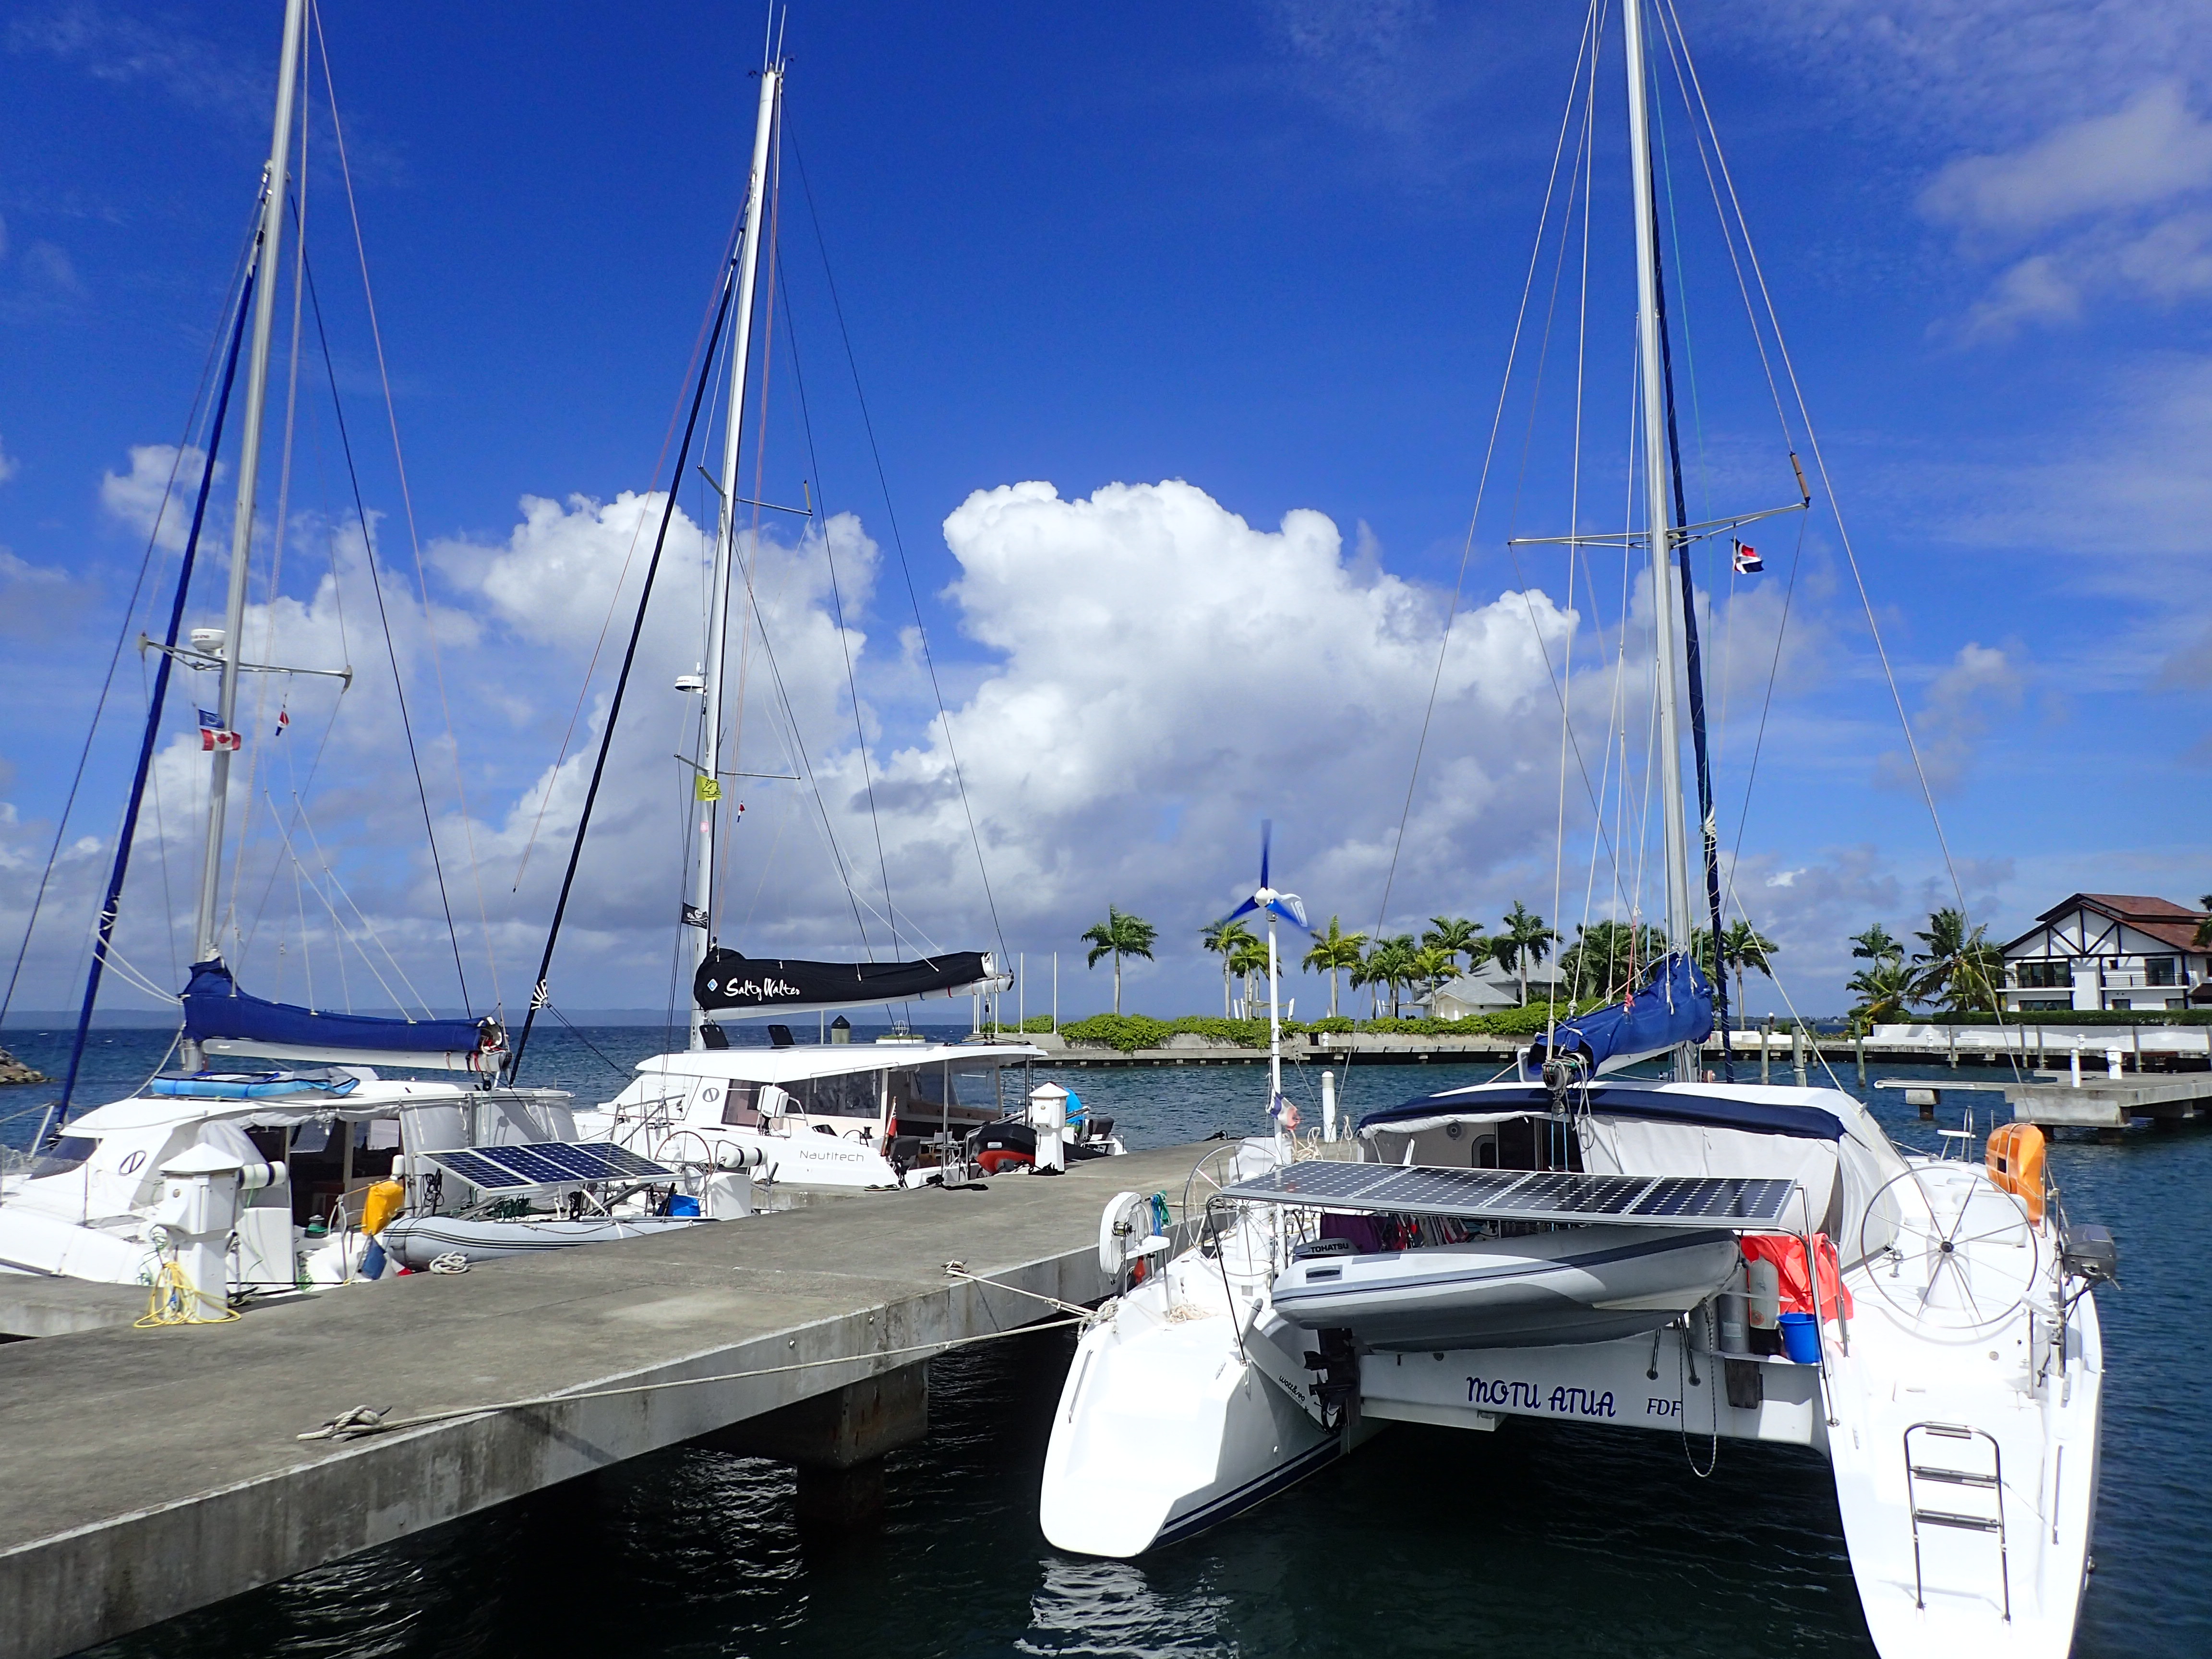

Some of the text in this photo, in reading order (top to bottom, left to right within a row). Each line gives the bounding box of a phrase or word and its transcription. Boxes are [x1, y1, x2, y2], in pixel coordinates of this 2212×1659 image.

[723, 977, 801, 1001] Salty Walter
[800, 1150, 864, 1162] Nautitech
[1310, 1243, 1349, 1253] TOHATSU
[1467, 1376, 1616, 1418] MOTU ATUA
[1647, 1398, 1682, 1417] FDF
